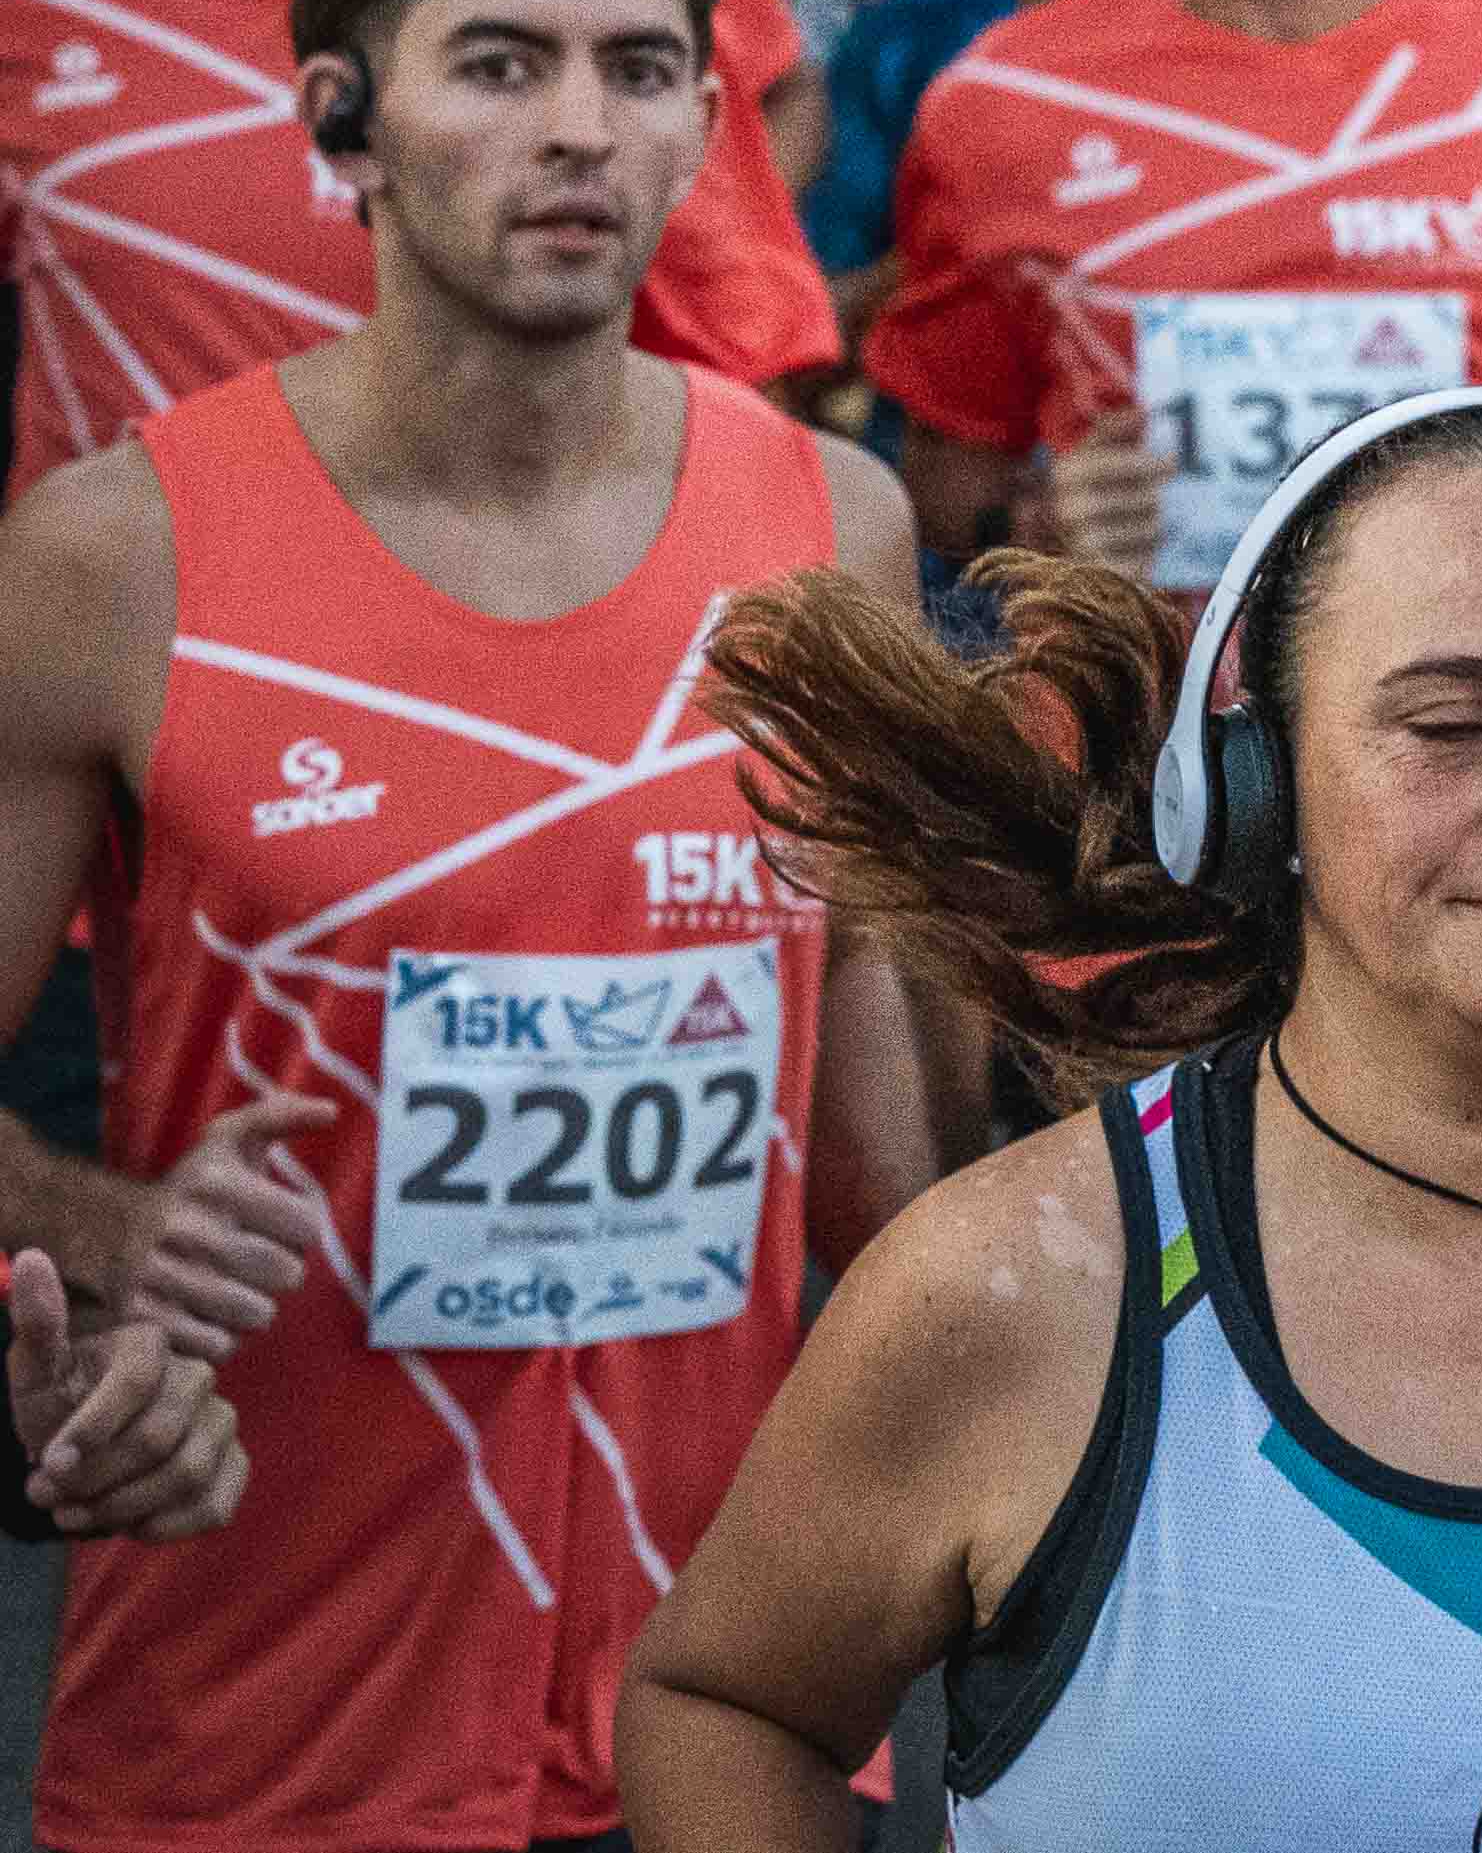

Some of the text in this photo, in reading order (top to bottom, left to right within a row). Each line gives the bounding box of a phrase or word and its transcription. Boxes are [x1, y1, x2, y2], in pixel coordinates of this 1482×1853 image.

[1162, 391, 1436, 481] 137
[634, 831, 764, 905] 15K
[435, 996, 550, 1051] 15K
[400, 1068, 762, 1205] 2202
